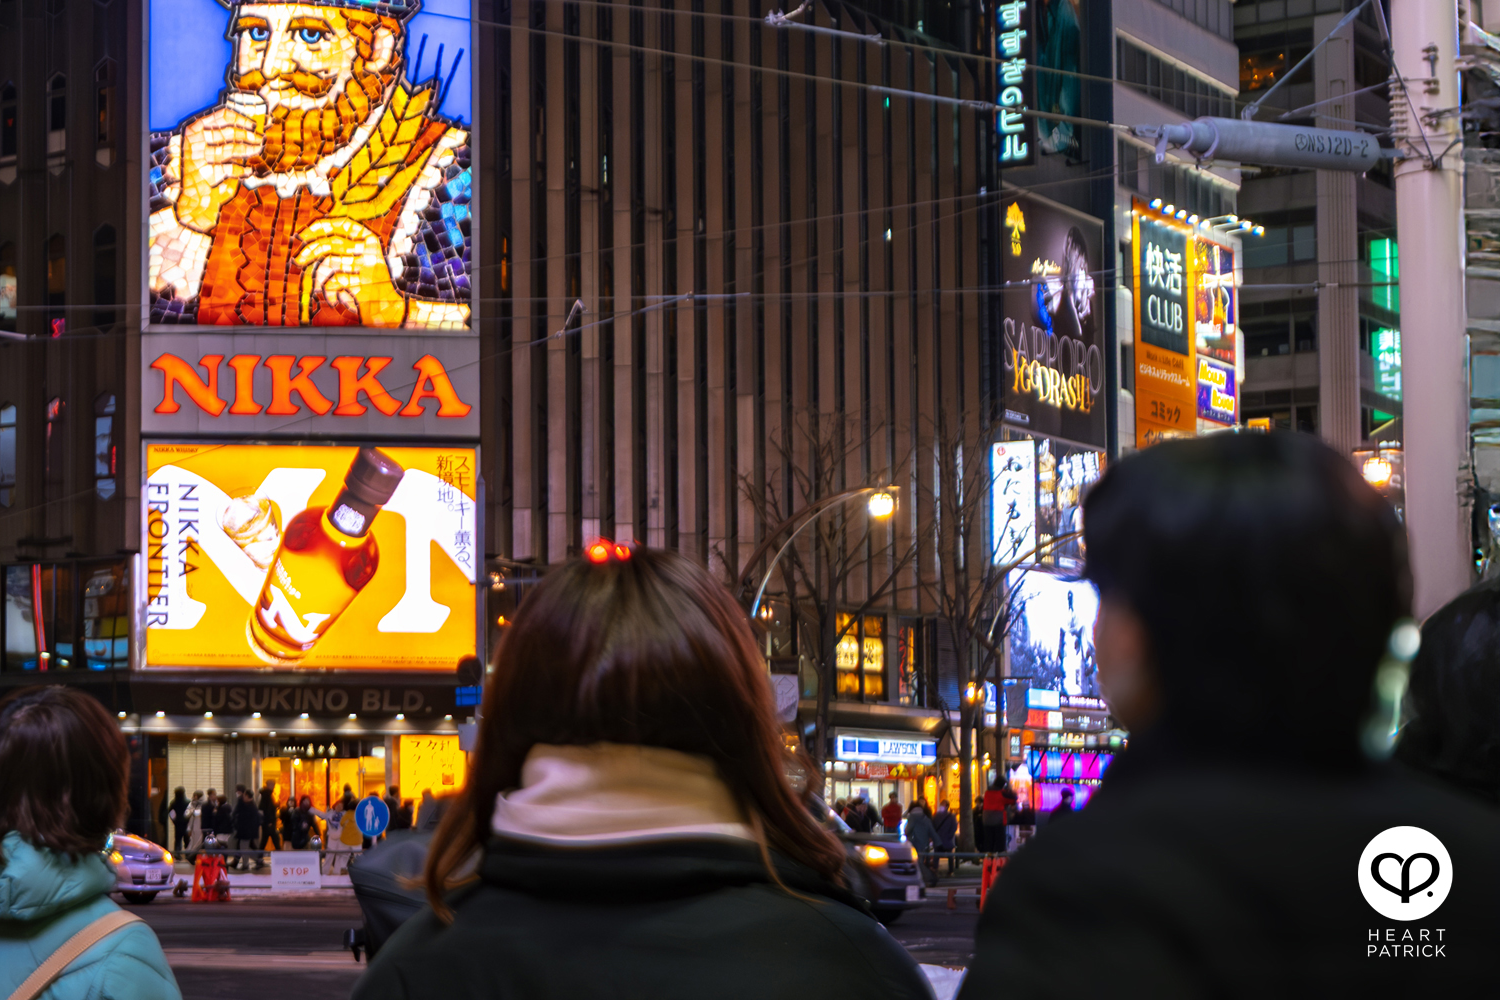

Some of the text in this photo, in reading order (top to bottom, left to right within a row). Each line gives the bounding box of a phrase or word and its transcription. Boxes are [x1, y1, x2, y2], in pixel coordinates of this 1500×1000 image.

[1000, 0, 1028, 161] すすきのビル
[1145, 241, 1183, 296] 快活
[1147, 294, 1183, 334] CLUB
[1004, 316, 1102, 394] SAPPORO
[150, 353, 472, 417] NIKKA
[1150, 400, 1181, 424] コミック
[147, 482, 169, 628] FRONTIER
[178, 483, 199, 578] NIKKA
[185, 687, 432, 712] SUSUKINO BLD.
[883, 741, 918, 755] LAWSON
[282, 866, 310, 876] STOP
